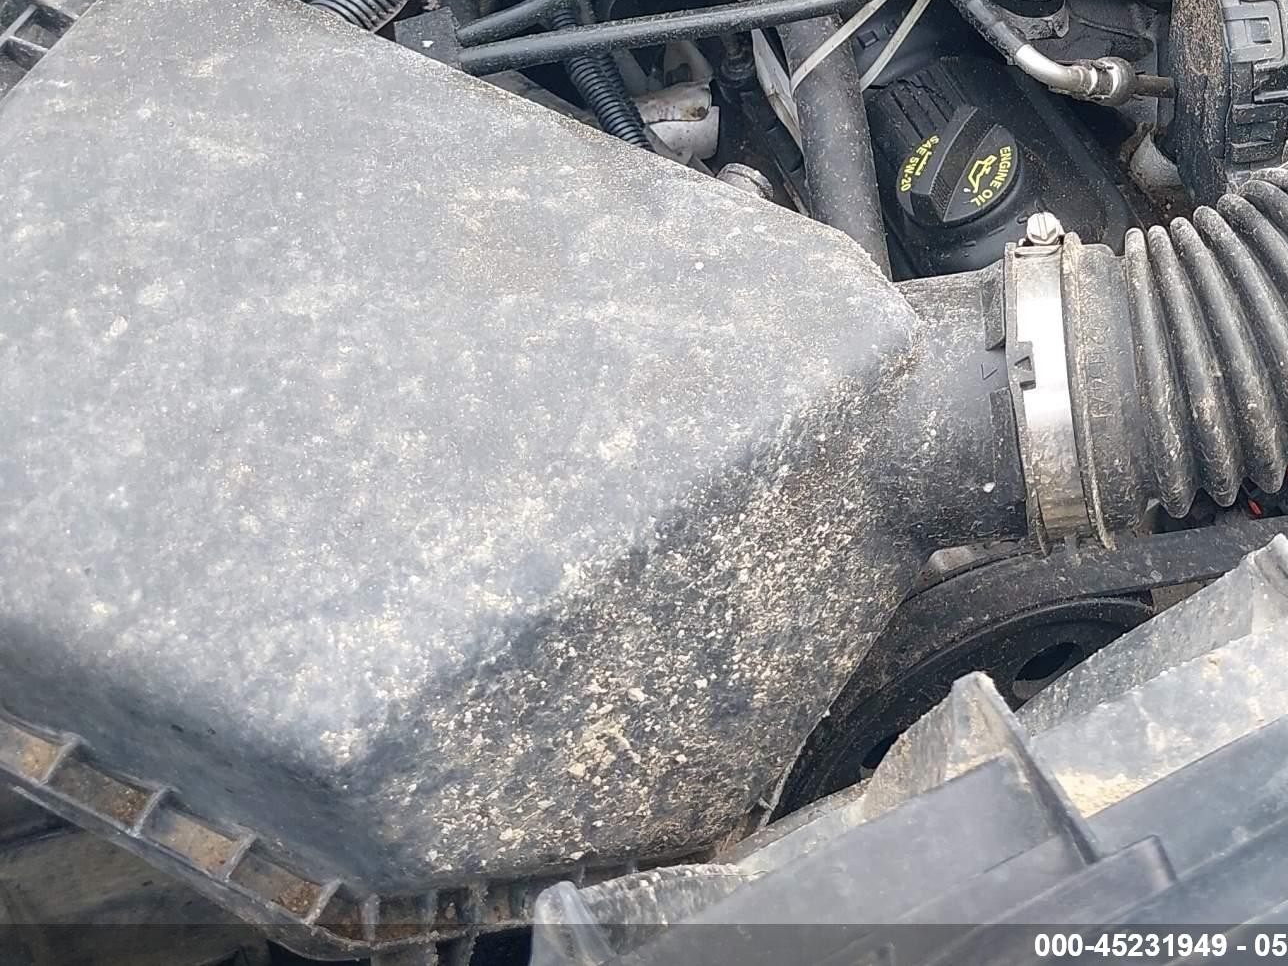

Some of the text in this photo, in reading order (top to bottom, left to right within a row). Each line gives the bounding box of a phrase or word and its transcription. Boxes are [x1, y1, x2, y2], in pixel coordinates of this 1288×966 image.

[900, 135, 940, 192] SAE 5W-20
[970, 146, 1012, 206] ENGINE OIL
